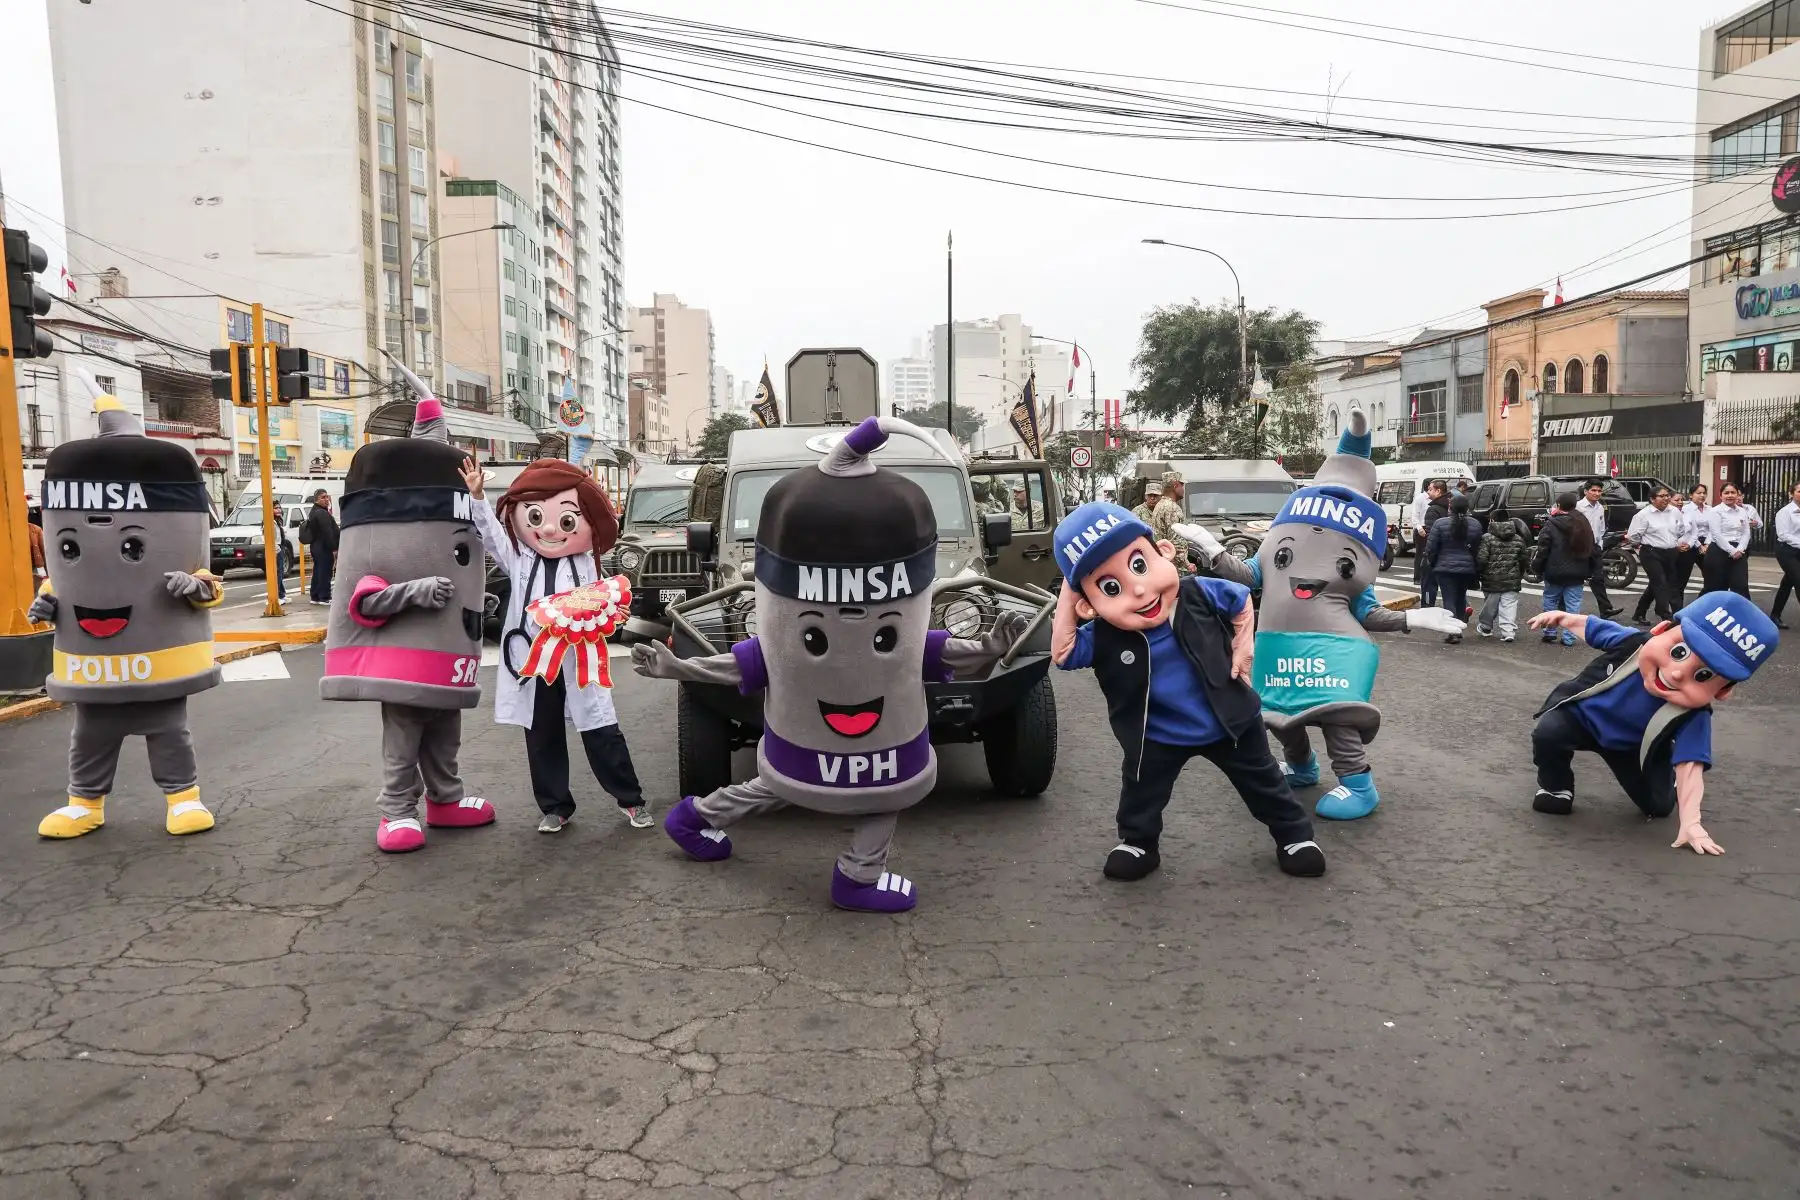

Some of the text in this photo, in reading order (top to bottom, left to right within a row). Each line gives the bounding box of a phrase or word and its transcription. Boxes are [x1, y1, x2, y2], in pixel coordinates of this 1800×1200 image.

[47, 480, 149, 510] MINSA
[1289, 497, 1375, 540] MINSA
[1063, 514, 1121, 564] MINSA
[798, 561, 913, 603] MINSA
[1705, 606, 1766, 661] MINSA
[66, 655, 152, 682] POLIO
[1265, 674, 1349, 688] Lima Centro
[1277, 657, 1326, 673] DIRIS
[817, 749, 898, 783] VPH
